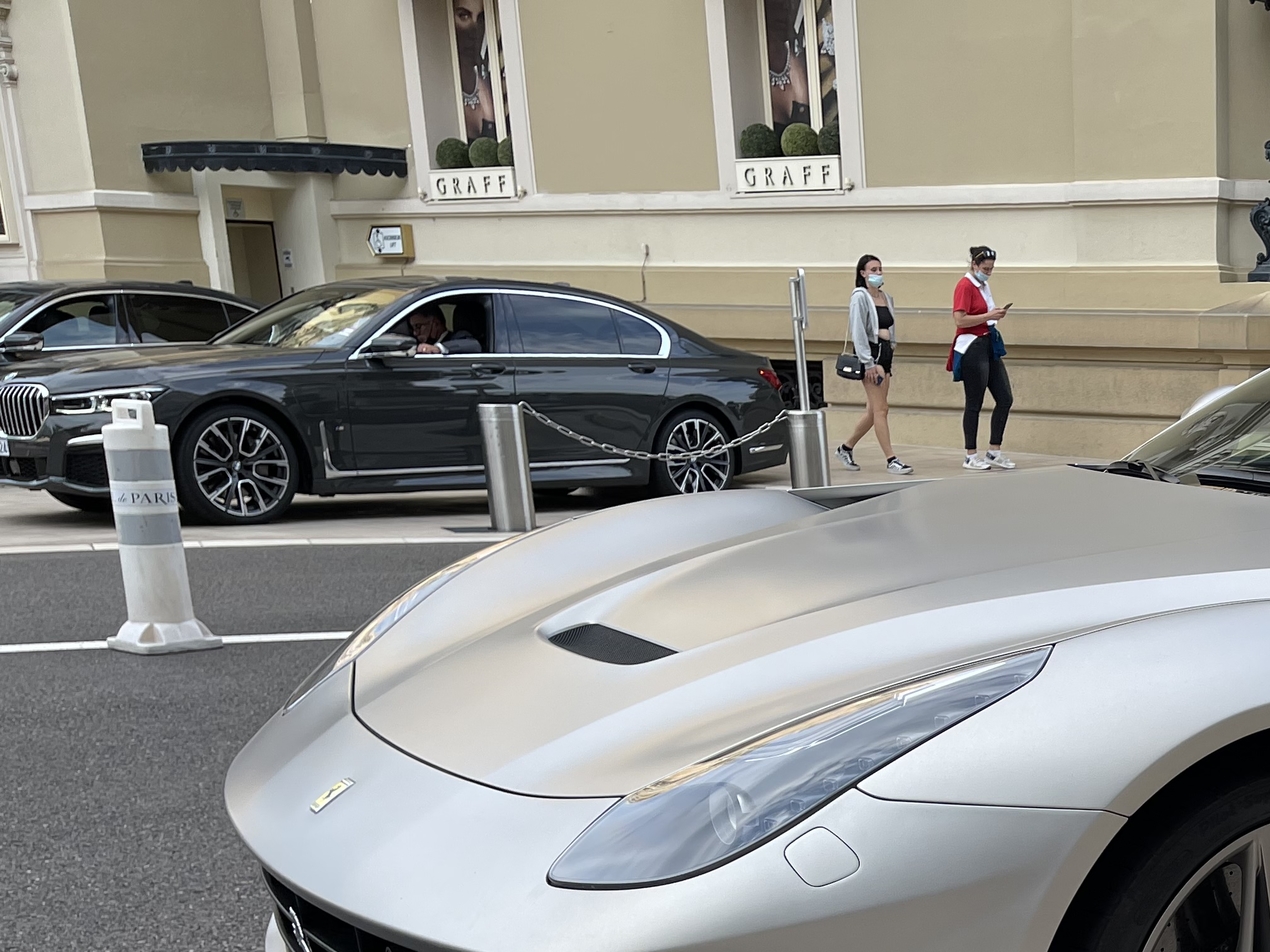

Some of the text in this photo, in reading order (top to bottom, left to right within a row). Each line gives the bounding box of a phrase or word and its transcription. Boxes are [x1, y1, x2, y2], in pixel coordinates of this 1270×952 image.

[436, 174, 506, 195] GRAFF
[744, 164, 830, 187] GRAFF
[131, 491, 176, 506] PARIS
